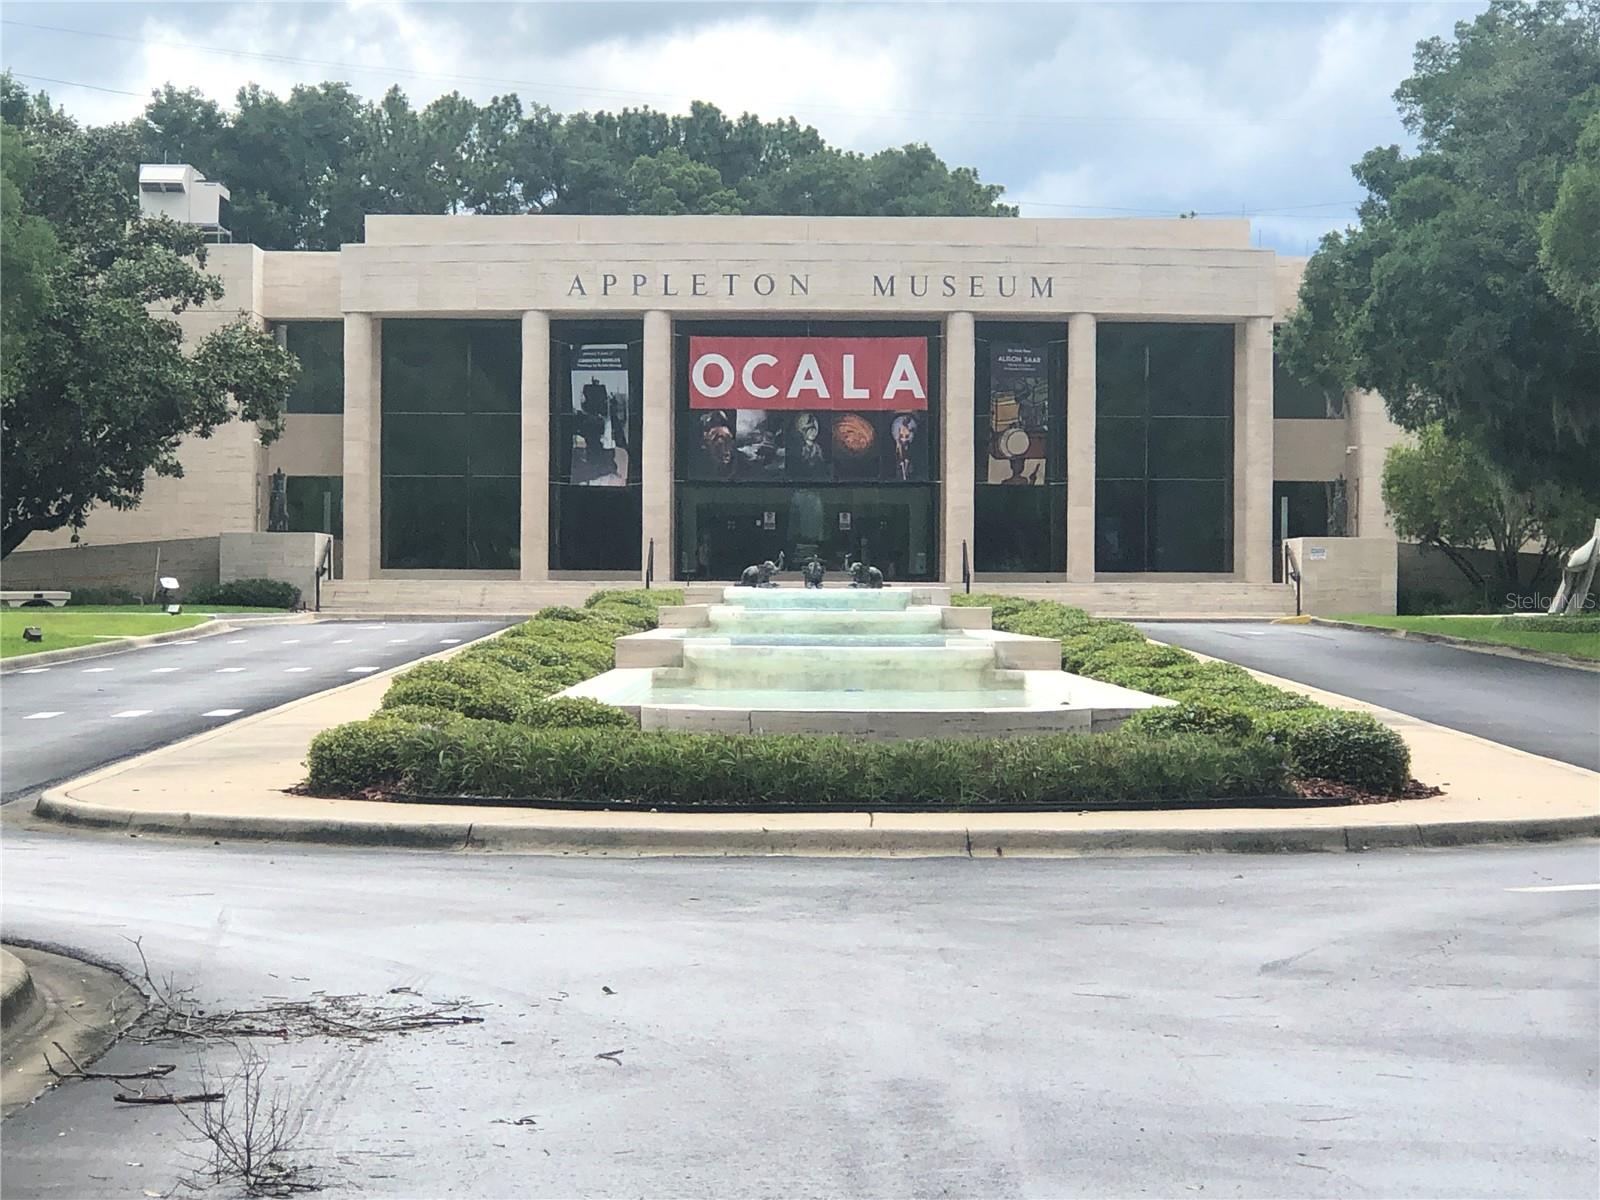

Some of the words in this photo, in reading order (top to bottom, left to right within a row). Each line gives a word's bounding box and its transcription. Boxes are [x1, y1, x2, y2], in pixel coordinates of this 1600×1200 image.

[567, 273, 810, 296] APPLETON
[872, 275, 1054, 298] MUSEUM
[691, 353, 927, 400] OCALA
